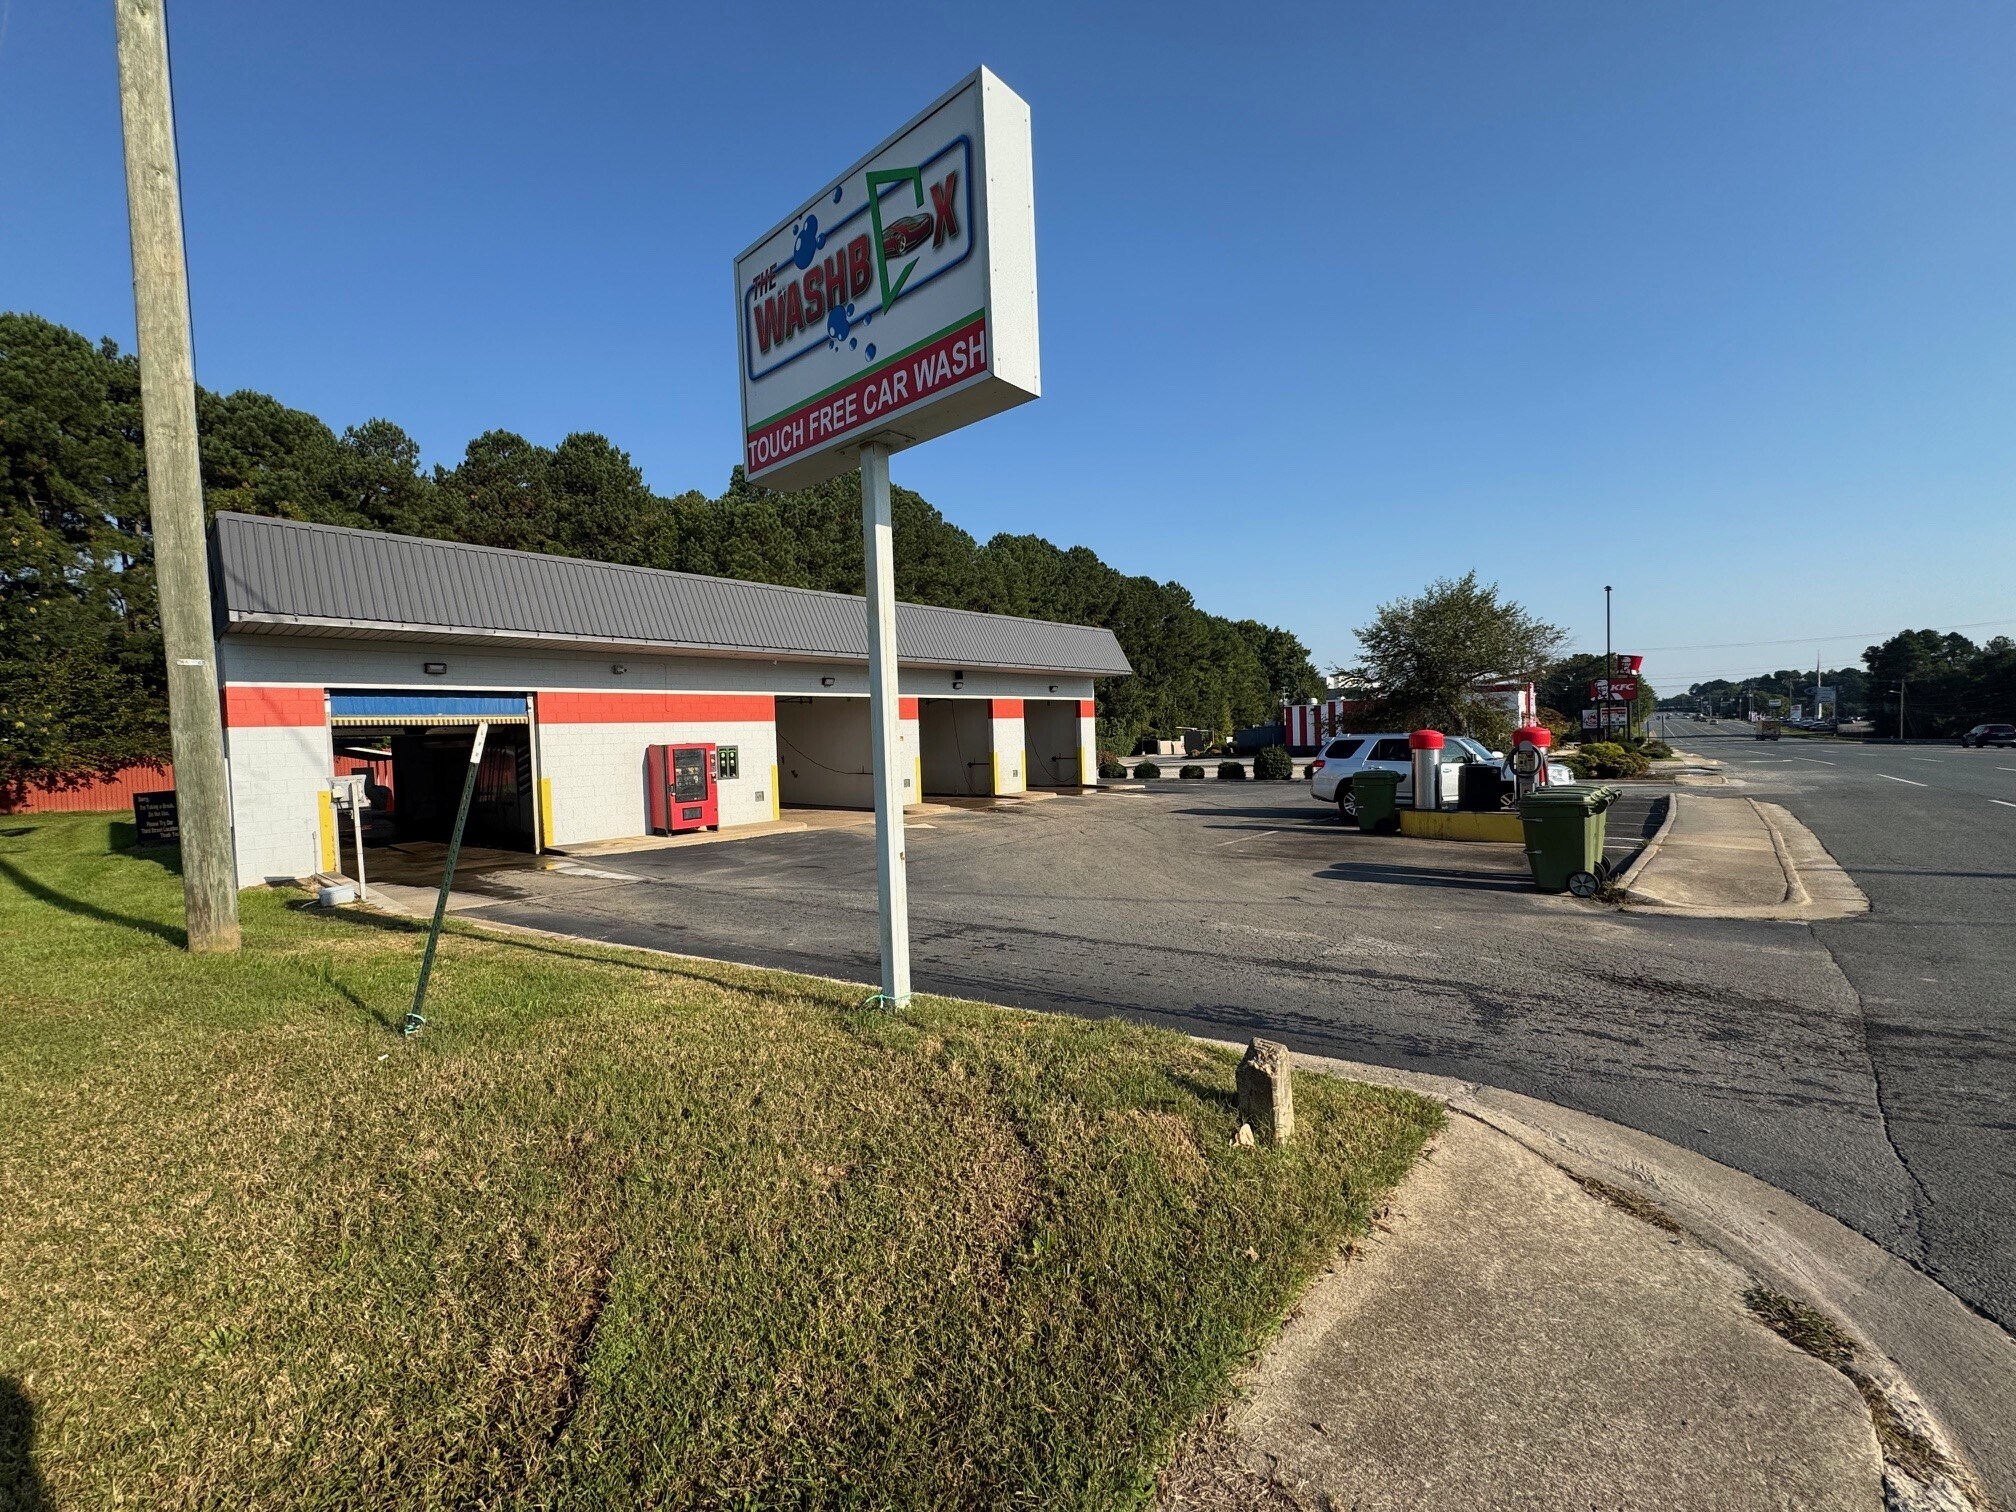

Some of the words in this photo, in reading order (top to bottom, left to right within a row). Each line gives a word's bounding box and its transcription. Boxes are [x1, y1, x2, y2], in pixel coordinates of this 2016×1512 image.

[753, 262, 778, 300] THE
[749, 418, 803, 467] TOUCH
[809, 393, 857, 441] FREE
[863, 370, 908, 414] CAR
[914, 330, 986, 392] WASH
[1610, 683, 1635, 691] KFC
